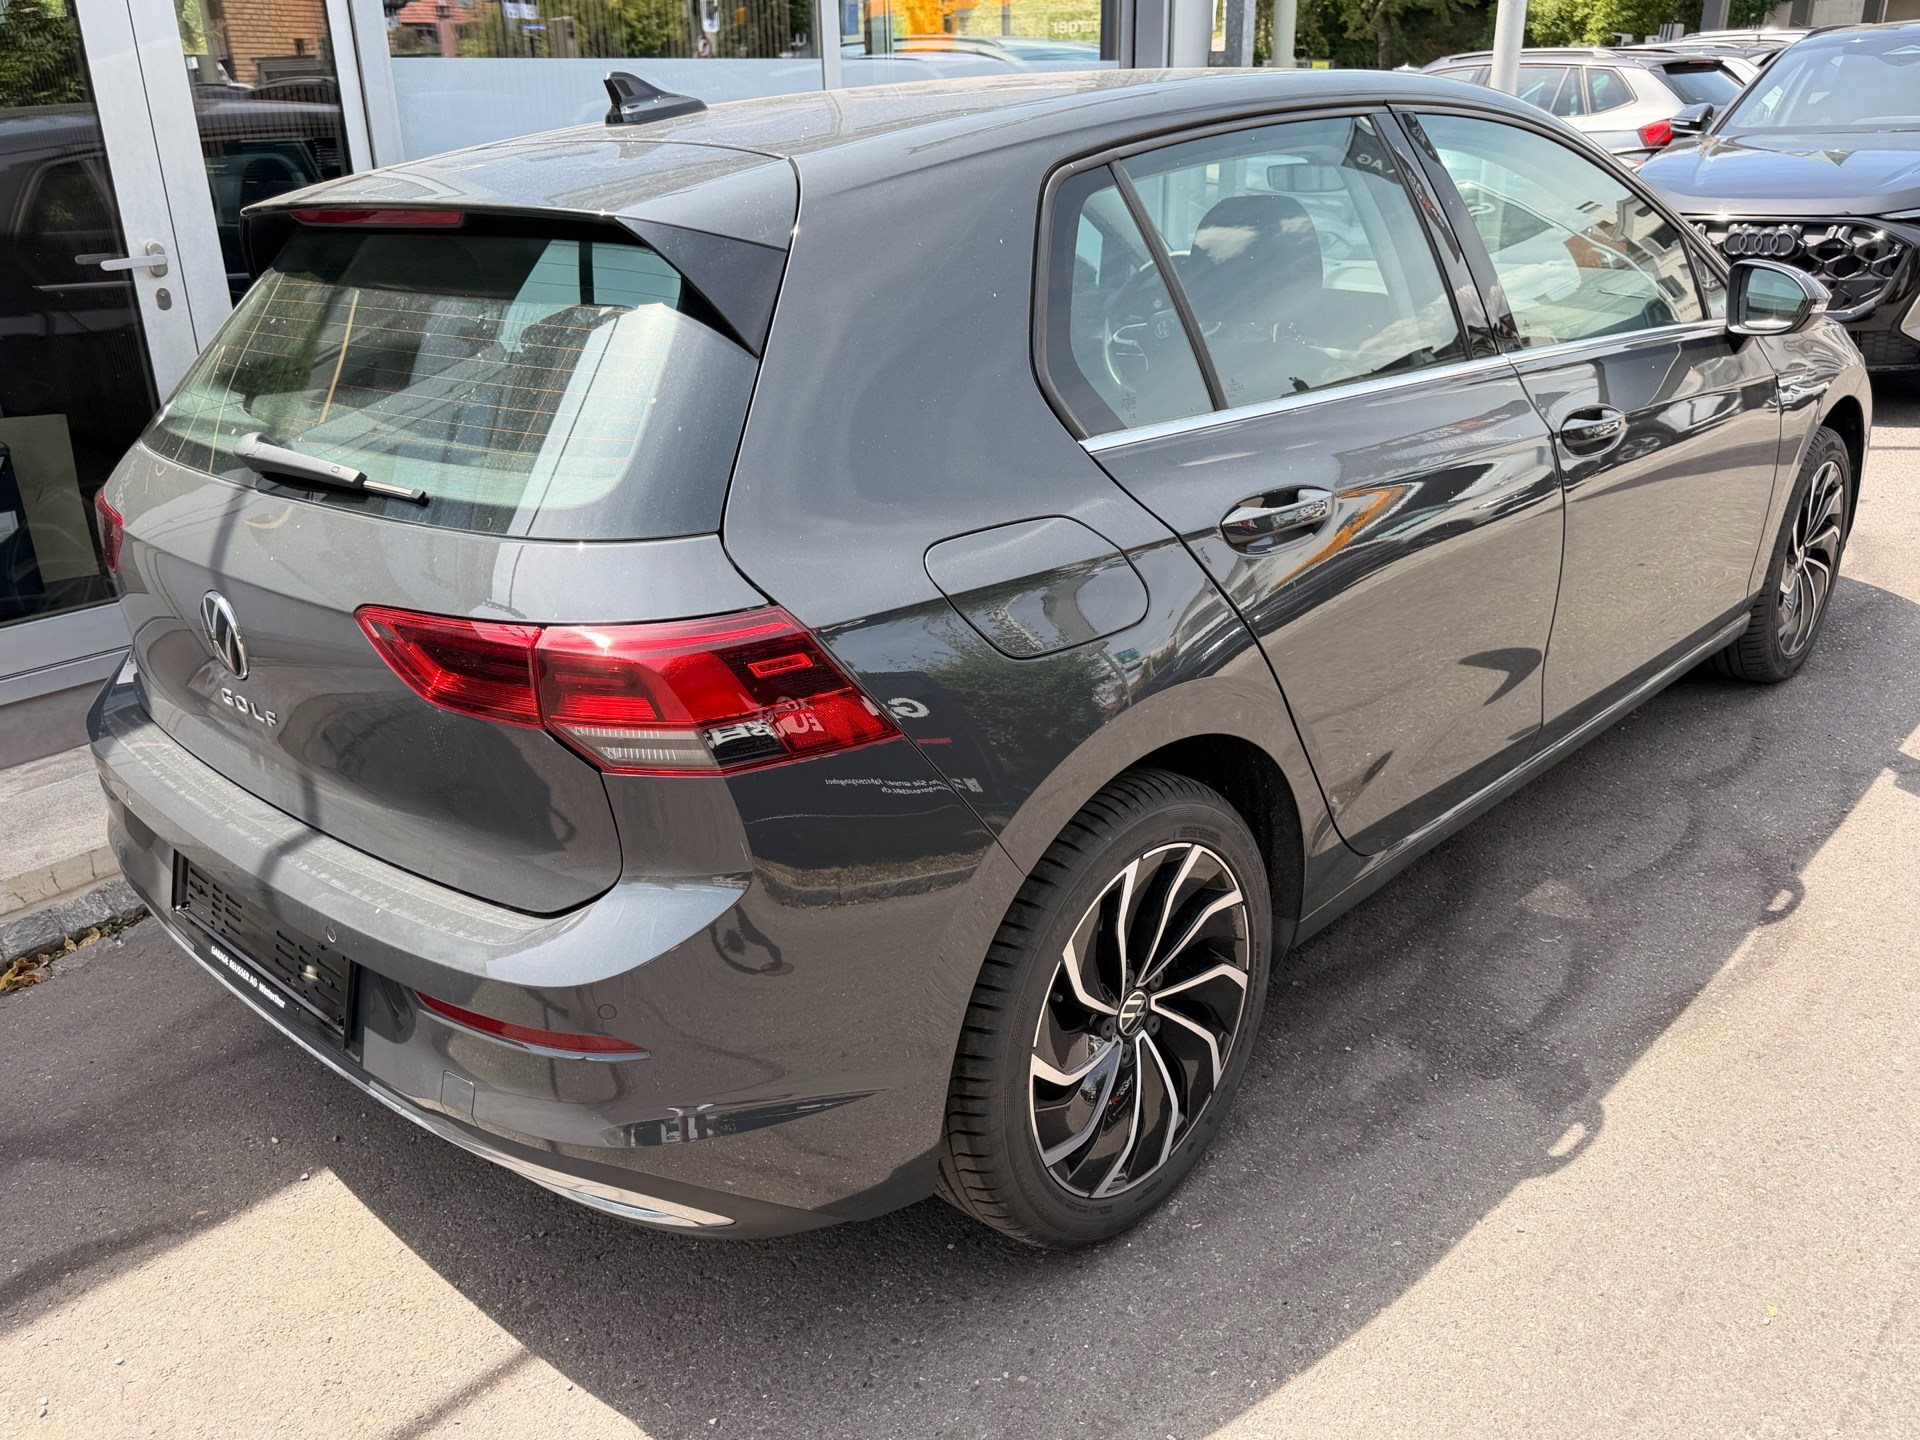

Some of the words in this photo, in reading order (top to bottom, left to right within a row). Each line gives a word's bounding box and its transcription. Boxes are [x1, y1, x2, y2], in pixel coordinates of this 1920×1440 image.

[221, 688, 278, 727] GOLF
[211, 945, 229, 966] GARAGE
[249, 975, 258, 988] AG
